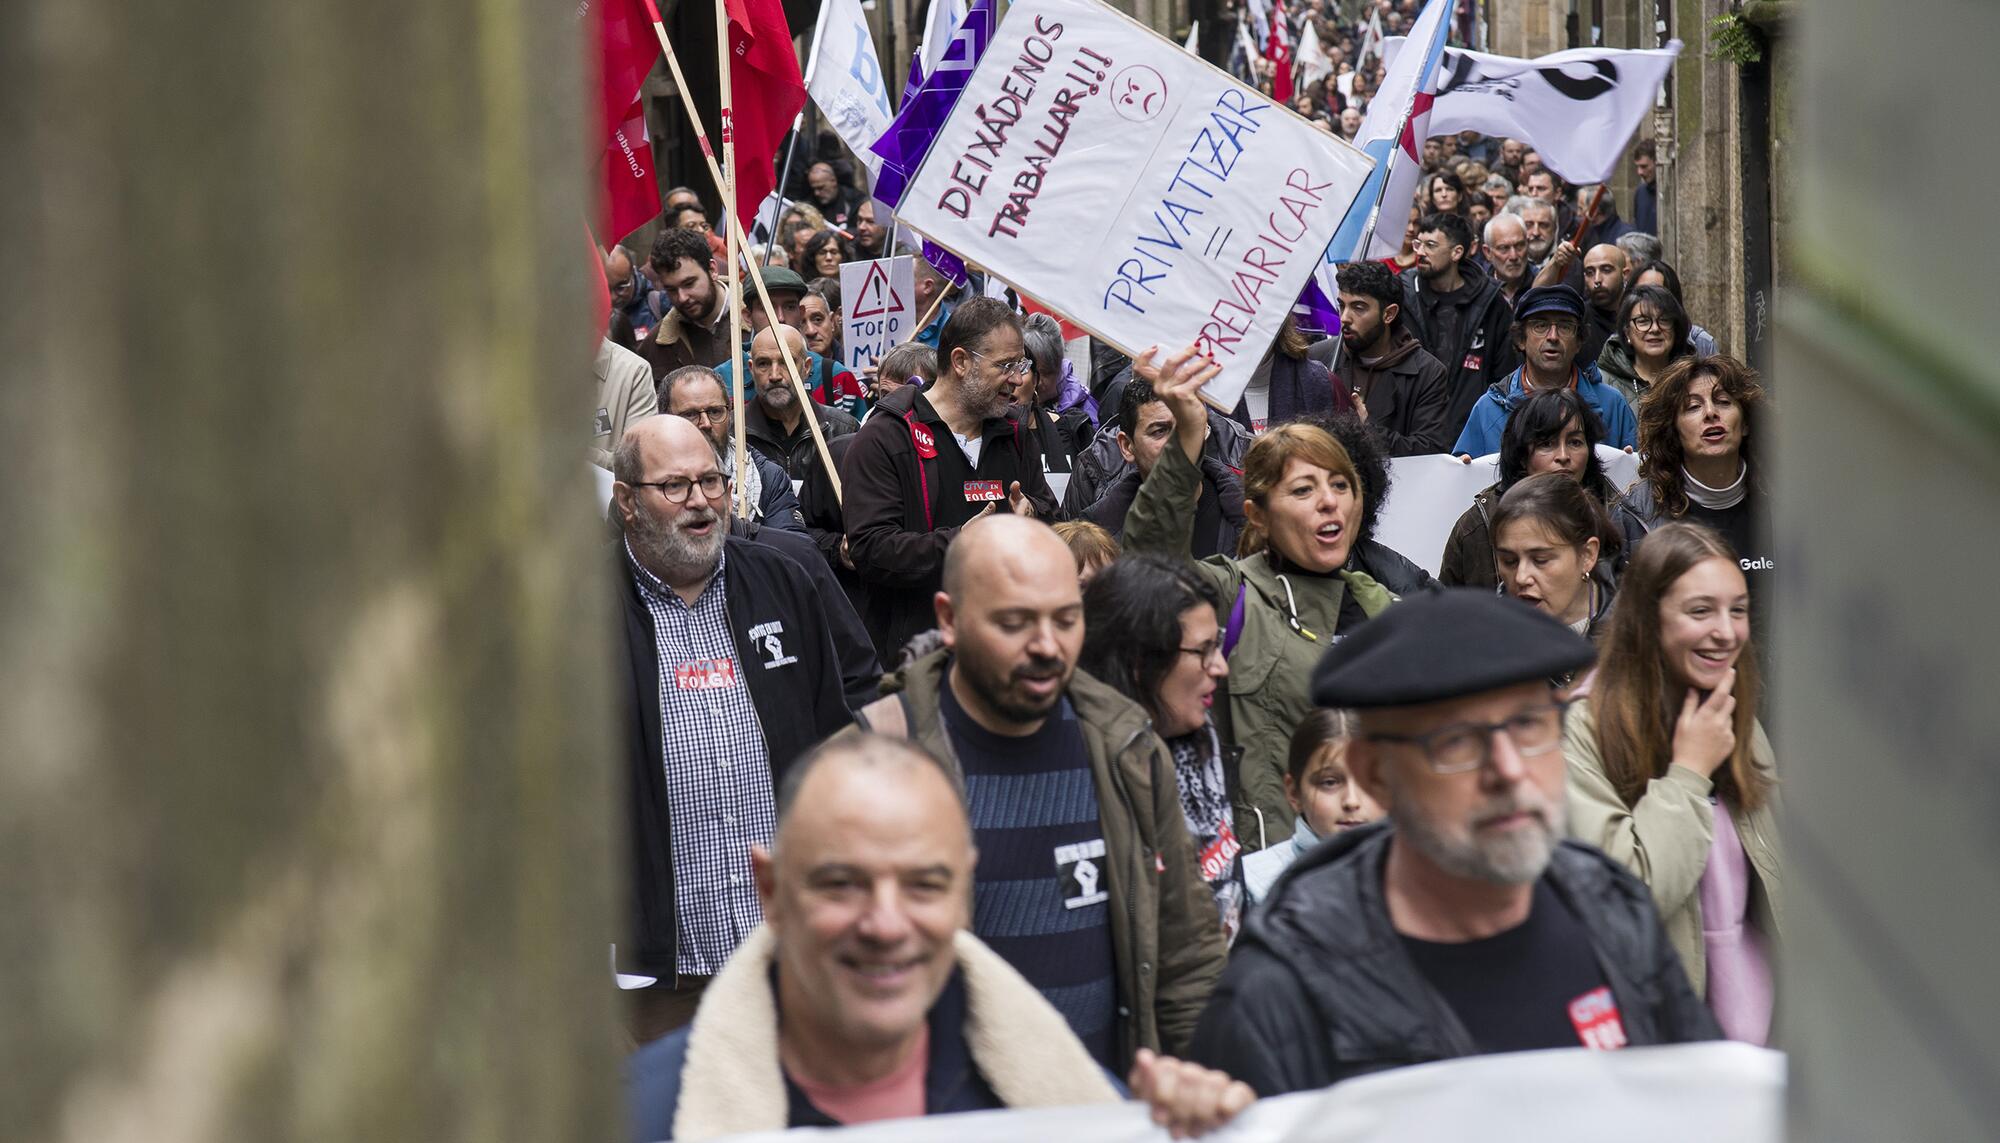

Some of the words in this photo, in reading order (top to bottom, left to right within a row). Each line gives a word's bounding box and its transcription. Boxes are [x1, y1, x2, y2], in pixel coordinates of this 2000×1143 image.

[938, 14, 1063, 220] DEIXÁDENOS
[988, 47, 1112, 238] TRABALLAR!!!
[1104, 88, 1271, 314] PRIVATIZAR
[1196, 168, 1333, 365] PREVARICAR
[964, 491, 1006, 502] FOLGA
[1740, 556, 1774, 570] Gale
[678, 672, 735, 689] FOLGA
